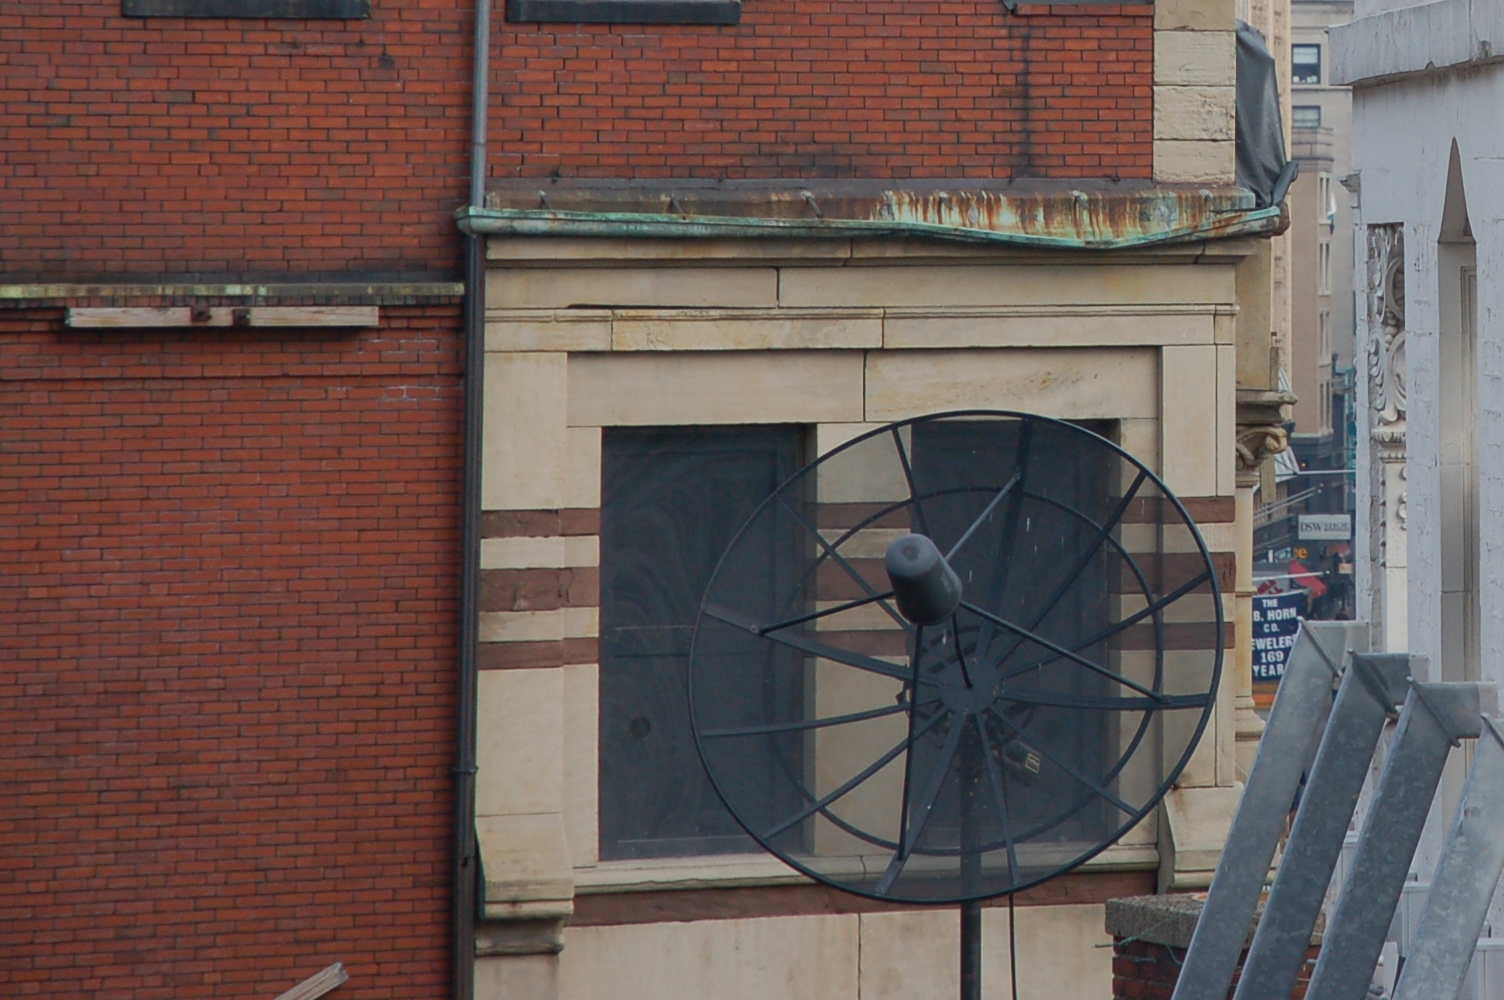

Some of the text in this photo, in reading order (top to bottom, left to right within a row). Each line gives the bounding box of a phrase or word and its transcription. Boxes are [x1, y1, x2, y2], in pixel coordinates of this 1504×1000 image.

[1300, 521, 1322, 532] DSW
[1262, 599, 1278, 608] THE
[1267, 607, 1297, 621] HORN
[1251, 634, 1297, 651] EWELER
[1261, 650, 1284, 663] 169
[1253, 663, 1285, 677] YEAR
